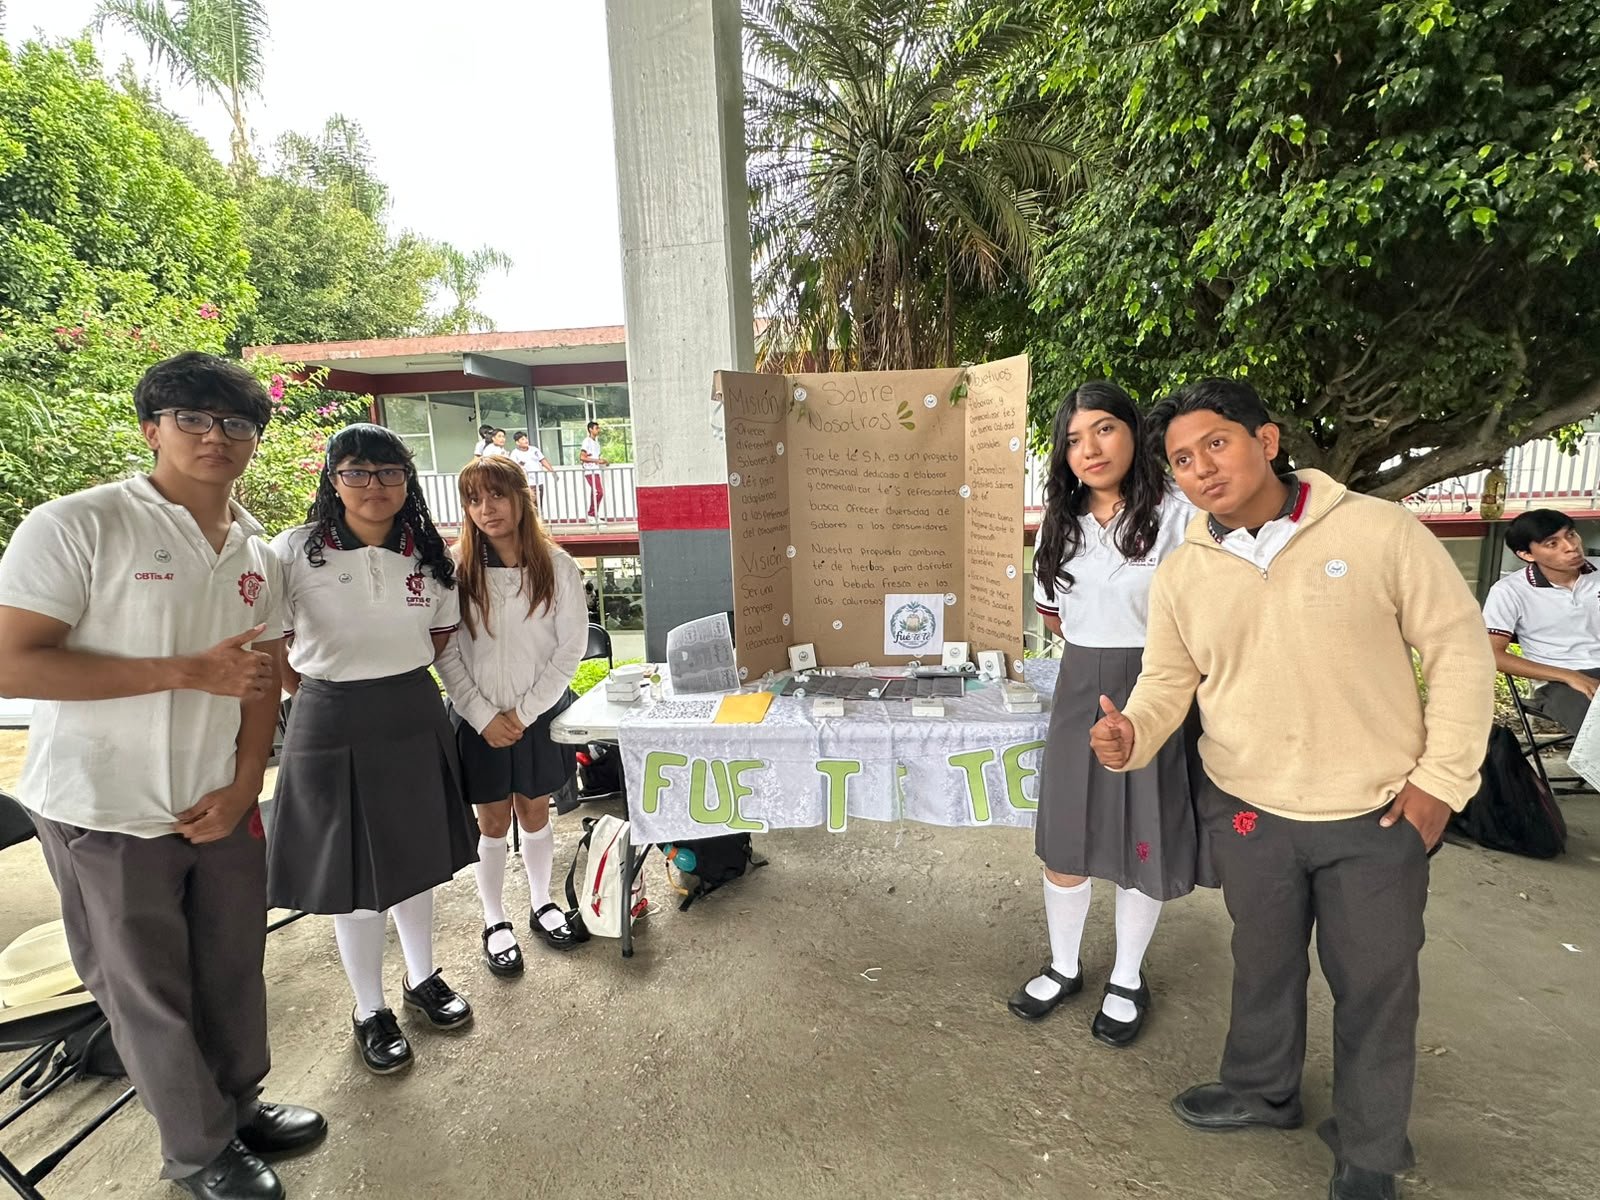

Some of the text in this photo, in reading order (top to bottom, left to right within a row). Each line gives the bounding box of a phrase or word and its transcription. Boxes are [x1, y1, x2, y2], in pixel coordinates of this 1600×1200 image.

[821, 376, 894, 406] Sobre
[728, 387, 780, 416] Misión
[807, 409, 892, 433] Nosotros
[888, 452, 900, 461] es
[904, 450, 920, 461] un
[922, 451, 959, 463] proyecto
[806, 466, 947, 480] empresarial dedicado a elaborar
[816, 481, 871, 494] comercializar
[809, 499, 840, 513] busca
[886, 505, 930, 517] diversidad
[936, 507, 951, 517] de
[871, 521, 886, 530] los
[891, 523, 948, 532] consumidores
[811, 543, 946, 557] Nuestra propuesta combina
[741, 545, 782, 573] Visión
[812, 560, 953, 573] té de hierbas para disfrutar
[813, 577, 834, 587] una
[842, 577, 876, 589] bebida
[917, 580, 929, 588] en
[936, 579, 949, 588] los
[743, 602, 773, 617] empresa
[642, 750, 766, 831] FUE
